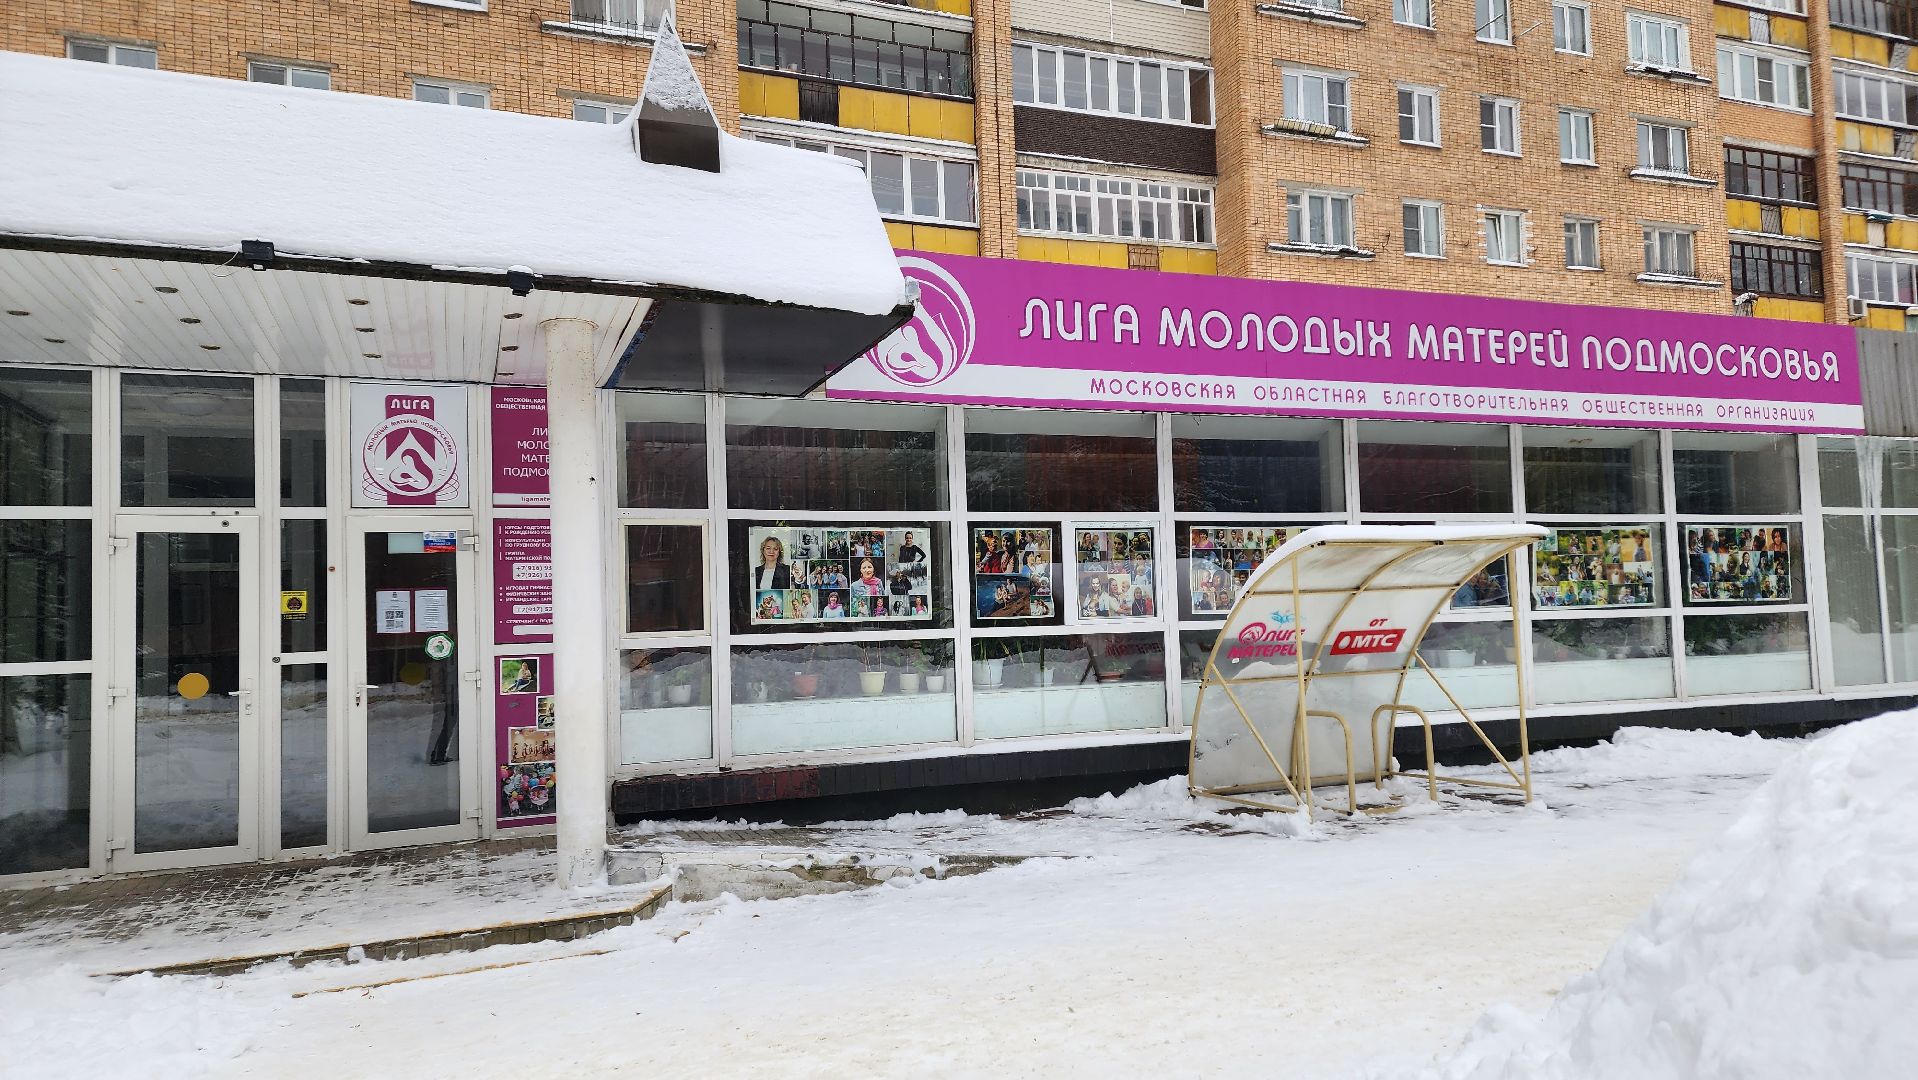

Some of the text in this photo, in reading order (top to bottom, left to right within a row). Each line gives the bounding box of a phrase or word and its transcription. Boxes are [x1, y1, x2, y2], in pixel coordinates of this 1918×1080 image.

[1019, 298, 1840, 382] ЛИГА МОЛОДЫХ МАТЕРЕЙ ПОДМОСКОВЬЯ
[390, 398, 430, 410] ЛИГА
[1090, 378, 1236, 399] МОСКОВСКАЯ
[1253, 385, 1366, 404] ОБЛАСТНАЯ
[1383, 390, 1569, 412] БЛАГОТВОРИТЕЛЬНАЯ
[1716, 405, 1816, 422] ОРГАНИЗАЦИЯ
[531, 427, 548, 436] ЛИ
[517, 440, 549, 450] МОЛО
[521, 454, 550, 463] МАТЕ
[503, 467, 550, 478] ПОДМО
[1369, 618, 1388, 627] ОТ
[1263, 629, 1306, 641] ЛИГ
[1350, 633, 1398, 649] МТС
